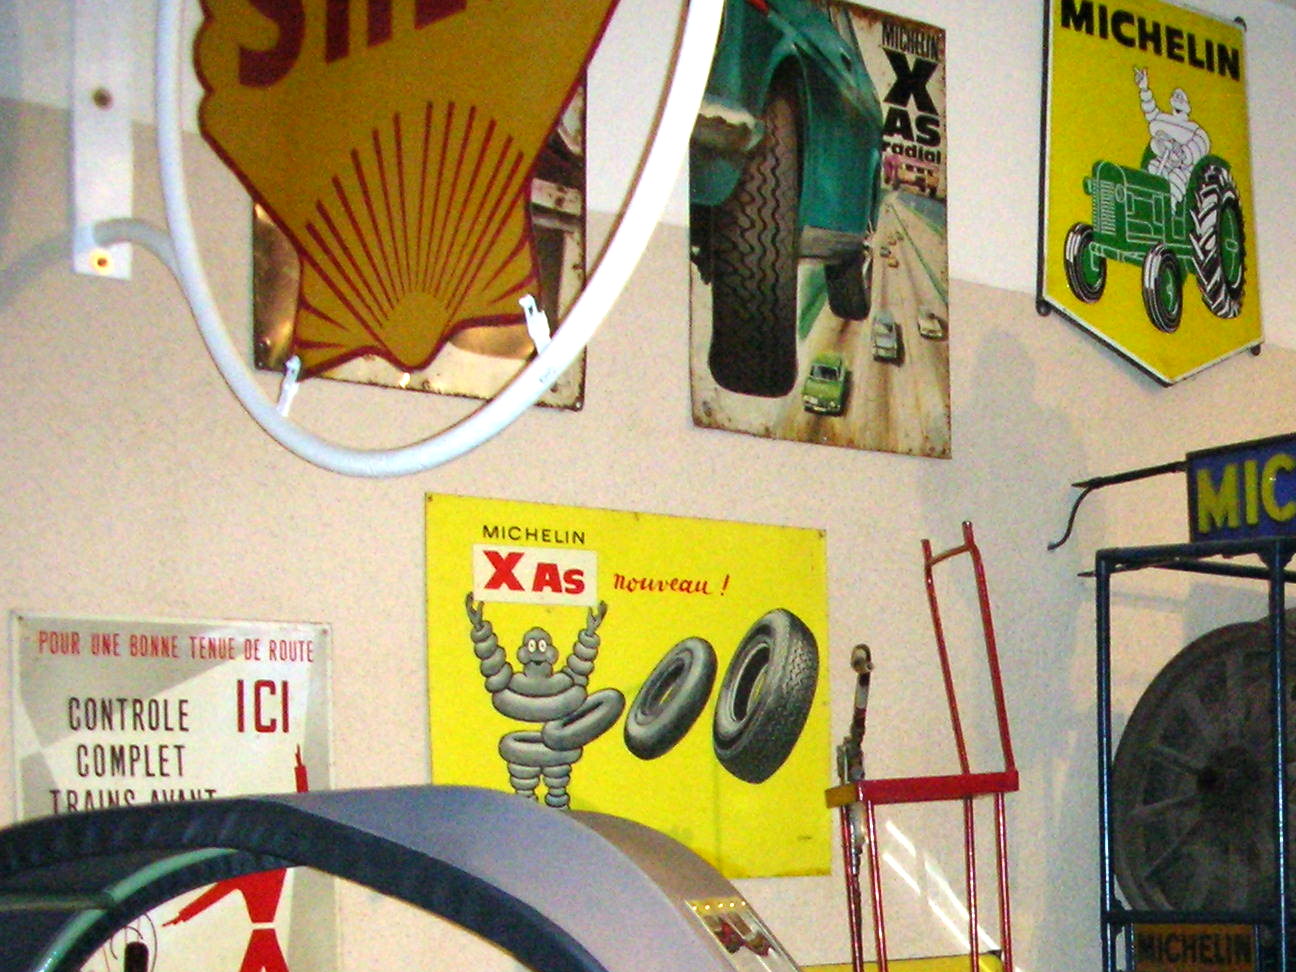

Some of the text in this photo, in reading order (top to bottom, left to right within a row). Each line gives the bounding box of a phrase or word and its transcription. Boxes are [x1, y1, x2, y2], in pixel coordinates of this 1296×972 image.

[881, 21, 939, 62] MICHELIN
[1061, 0, 1241, 81] MICHELIN
[882, 47, 940, 117] X
[882, 107, 942, 147] AS
[482, 525, 586, 545] MICHELIN
[38, 630, 314, 663] POUR UNE BONNE TENUE DE ROUTE
[67, 696, 191, 733] CONTROLE
[236, 679, 290, 734] ICI
[76, 744, 187, 778] COMPLET
[1137, 930, 1252, 966] MICHELIN
